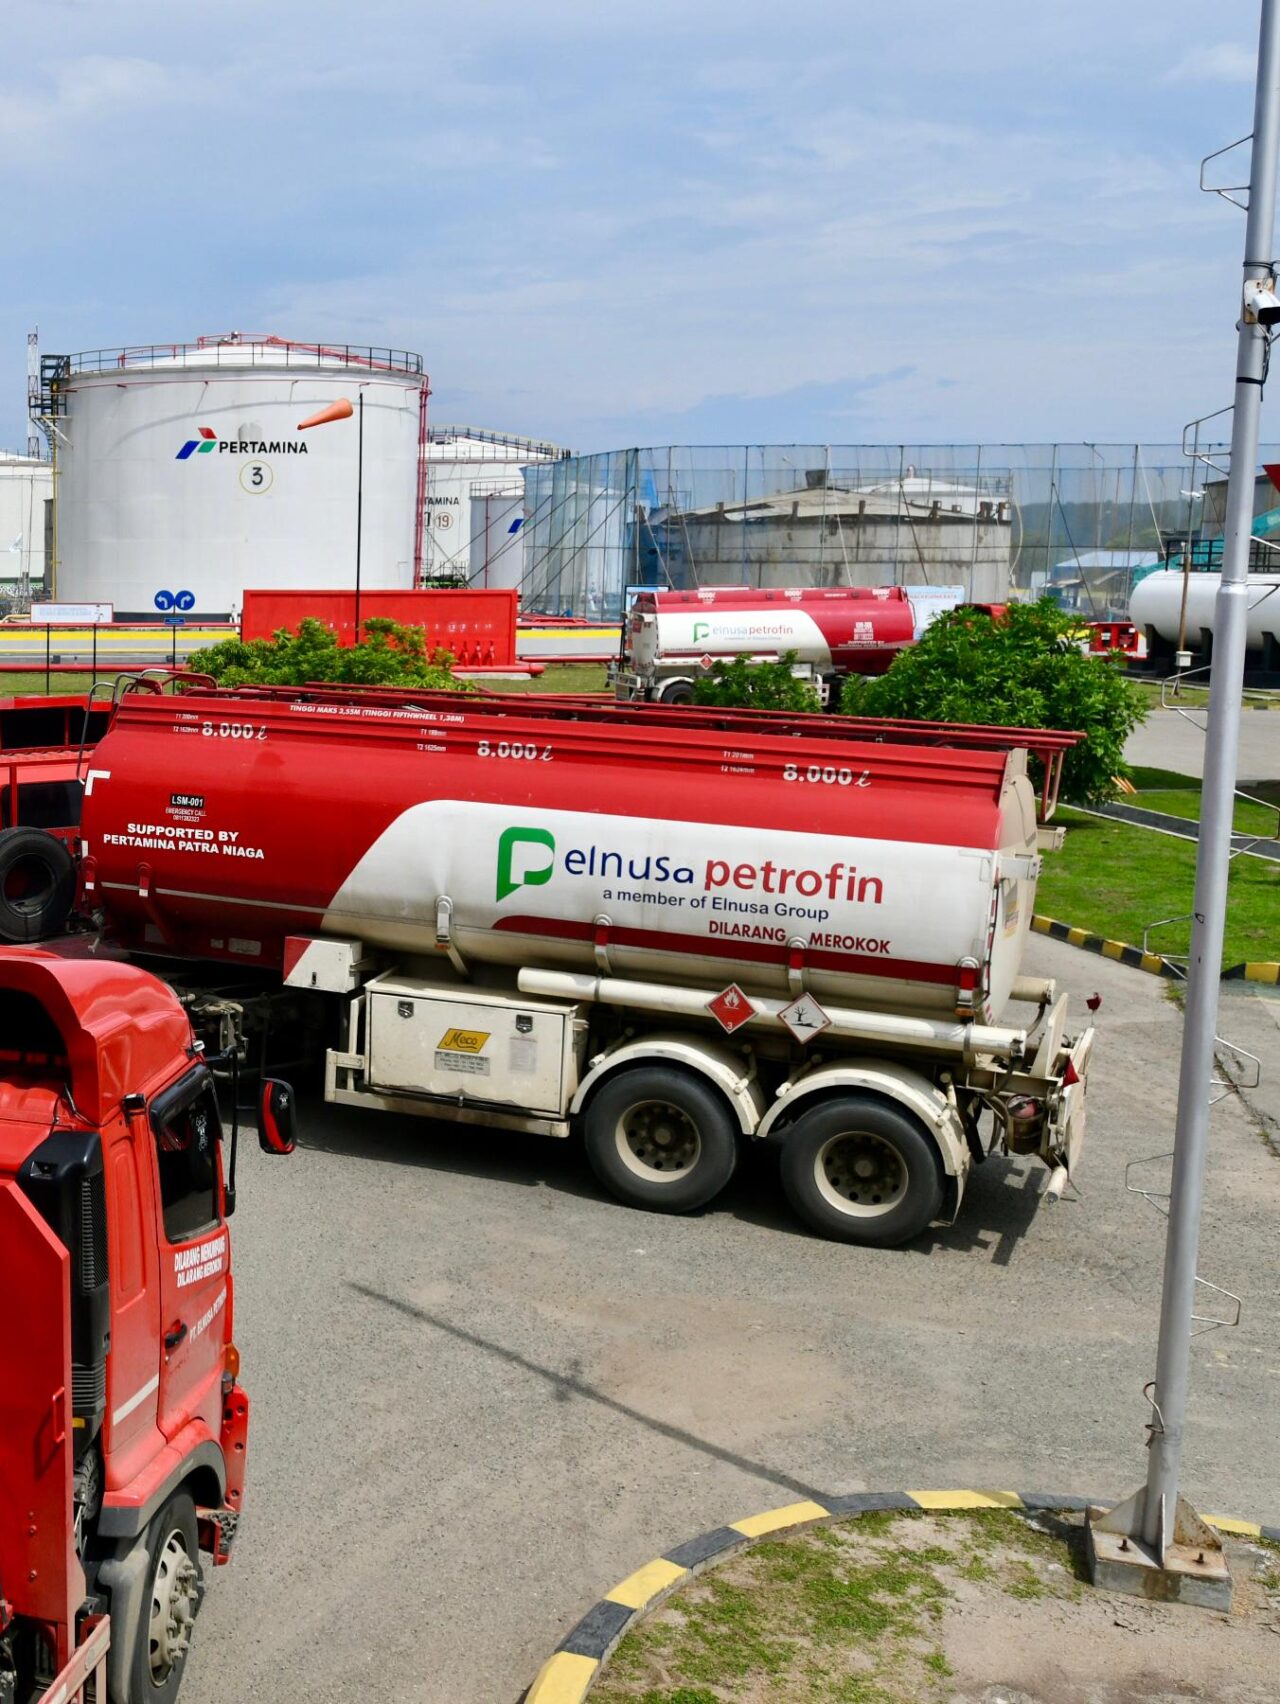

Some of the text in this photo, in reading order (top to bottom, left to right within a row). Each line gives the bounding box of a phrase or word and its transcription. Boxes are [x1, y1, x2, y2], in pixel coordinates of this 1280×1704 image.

[219, 441, 308, 454] PERTAMINA
[252, 467, 264, 486] 3
[437, 515, 450, 528] 19
[289, 704, 316, 713] TINGGI
[317, 706, 338, 715] MAKS
[172, 795, 204, 808] LSM-001
[127, 823, 239, 843] SUPPORTED BY
[103, 834, 265, 860] PERTAMINA PATRA NIAGA
[564, 845, 884, 905] elnusa petrofin
[602, 888, 830, 923] a member of Elnusa Group
[708, 920, 891, 955] DILARANG MEROKOK
[727, 1021, 733, 1030] 3
[174, 1246, 201, 1273] DILARANG
[177, 1265, 204, 1289] DILARANG
